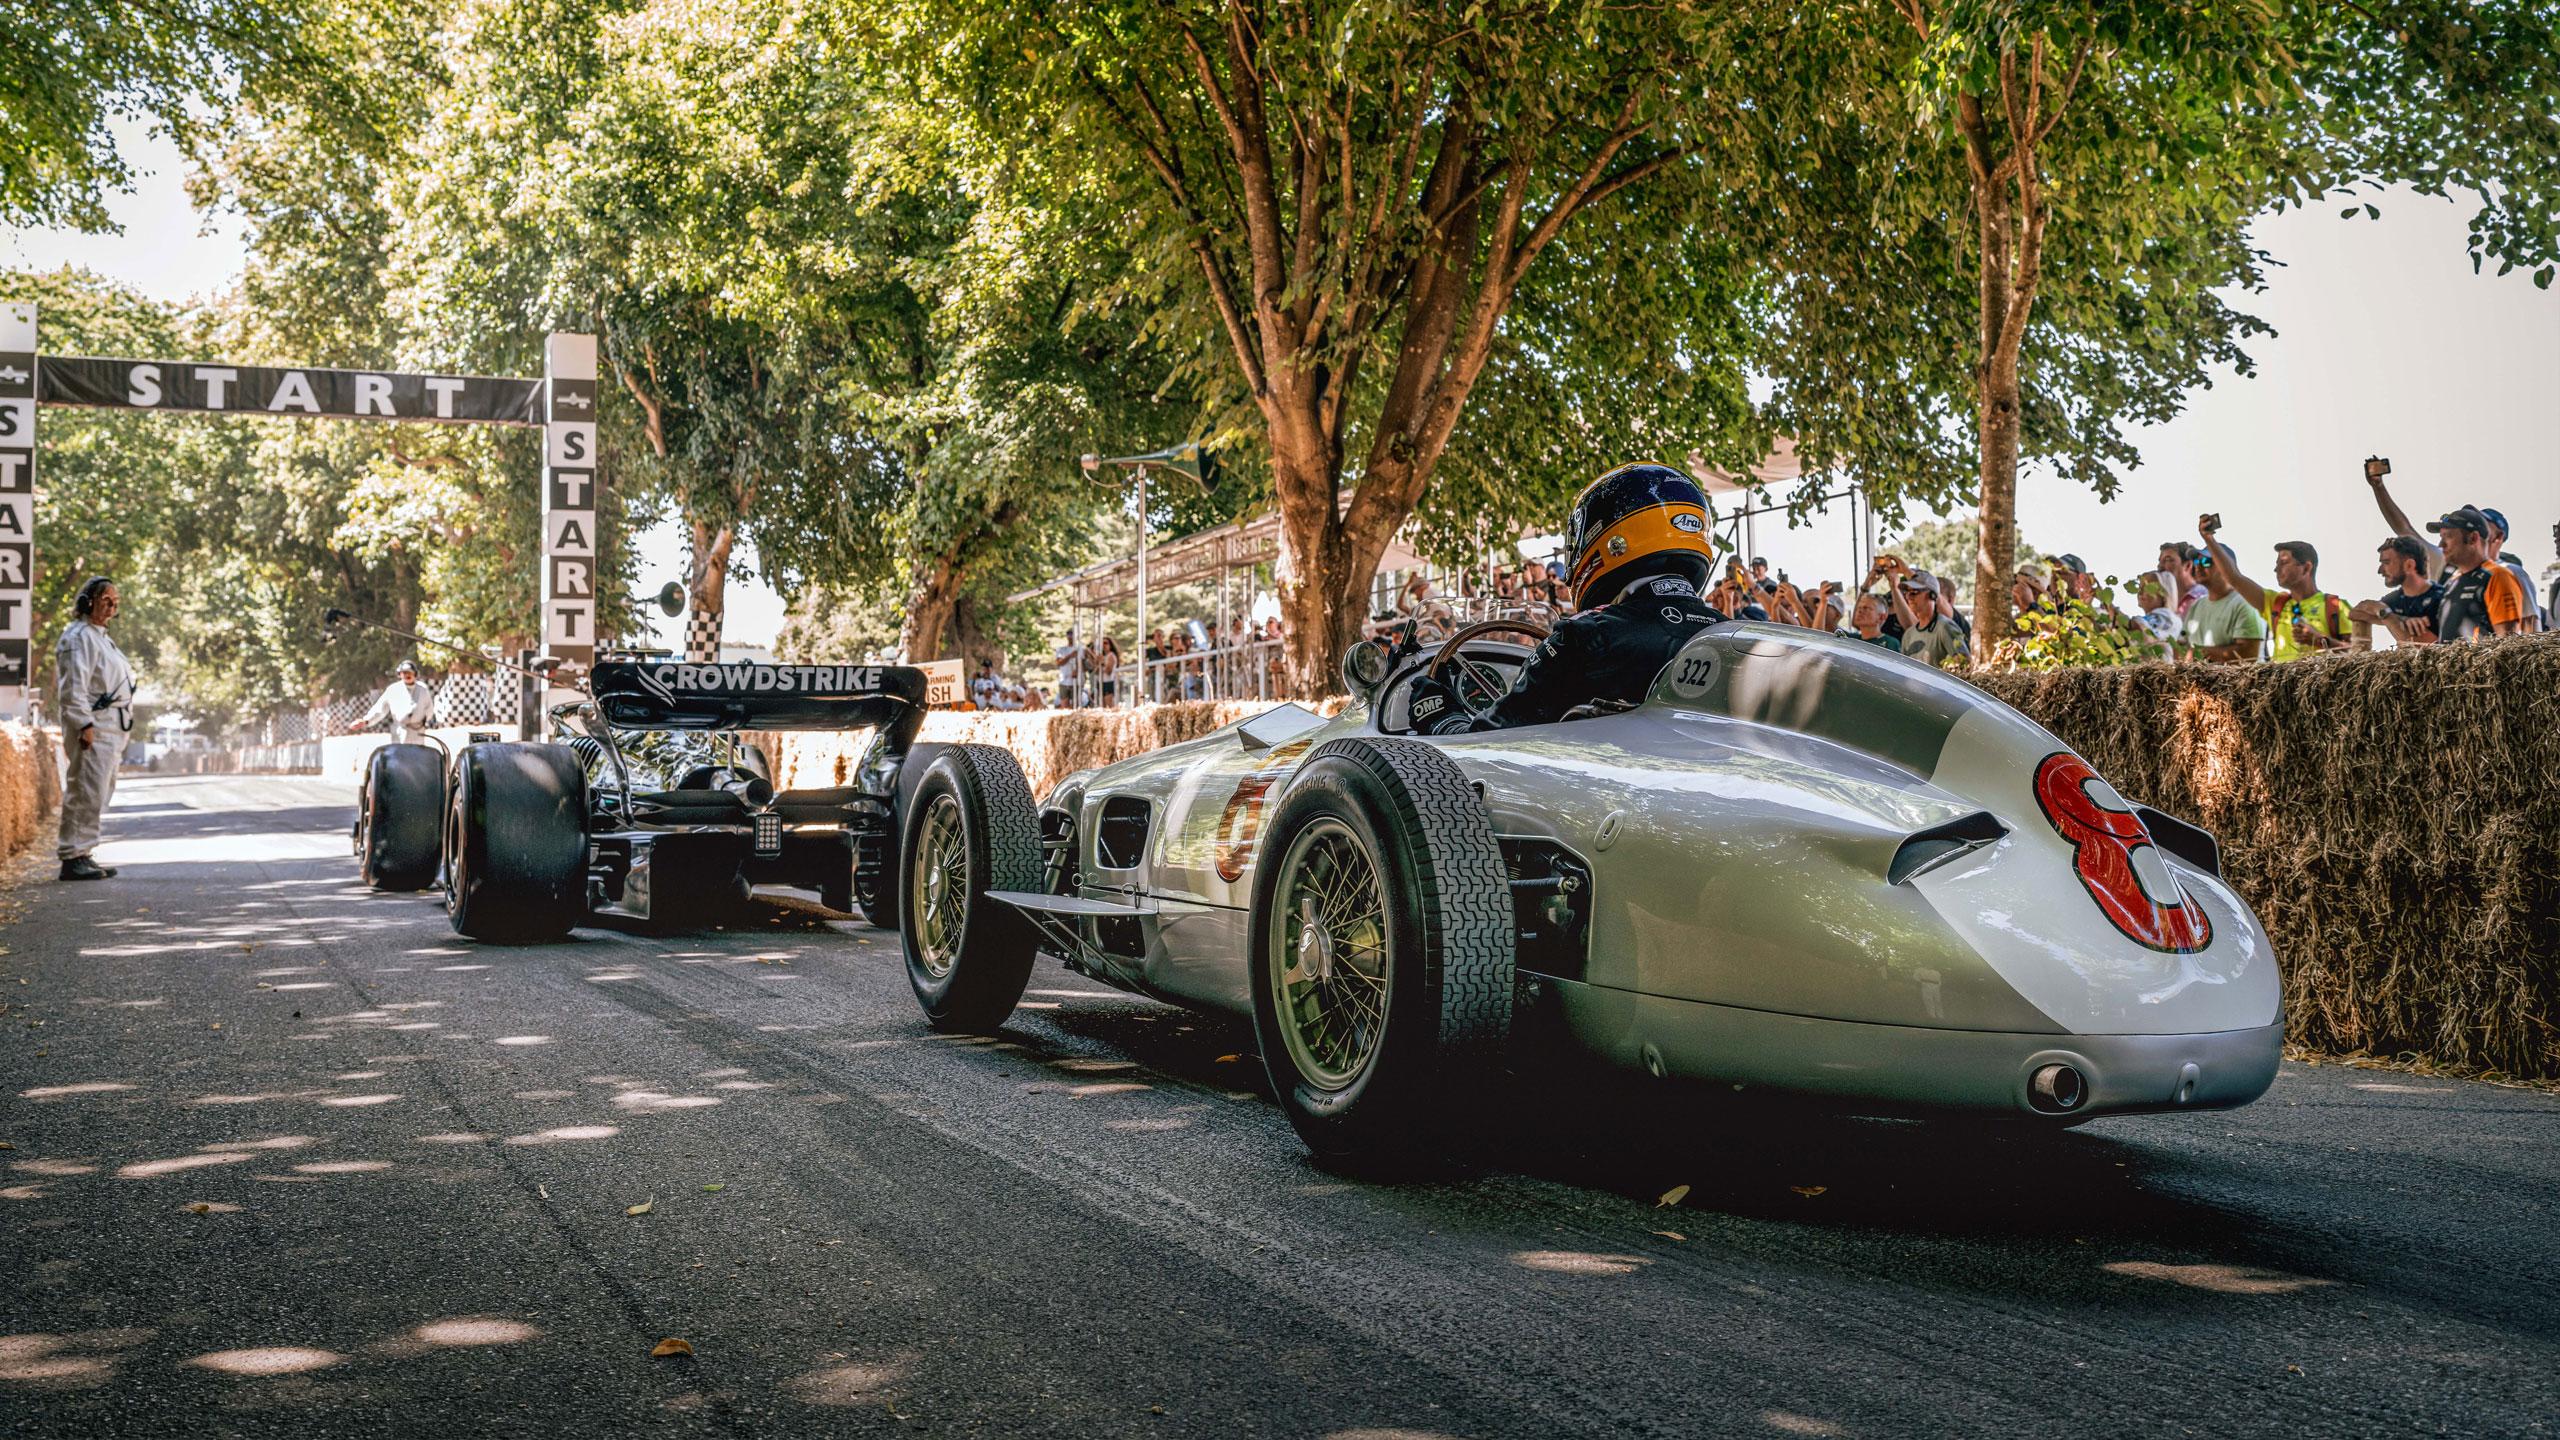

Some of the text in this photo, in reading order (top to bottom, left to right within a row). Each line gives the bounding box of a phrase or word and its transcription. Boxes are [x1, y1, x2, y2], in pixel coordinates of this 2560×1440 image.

[129, 364, 465, 418] START
[555, 431, 590, 638] START
[654, 664, 883, 692] CROWDSTRIKE
[1677, 657, 1712, 688] 322
[1413, 698, 1444, 717] OMP
[2032, 751, 2214, 955] 8
